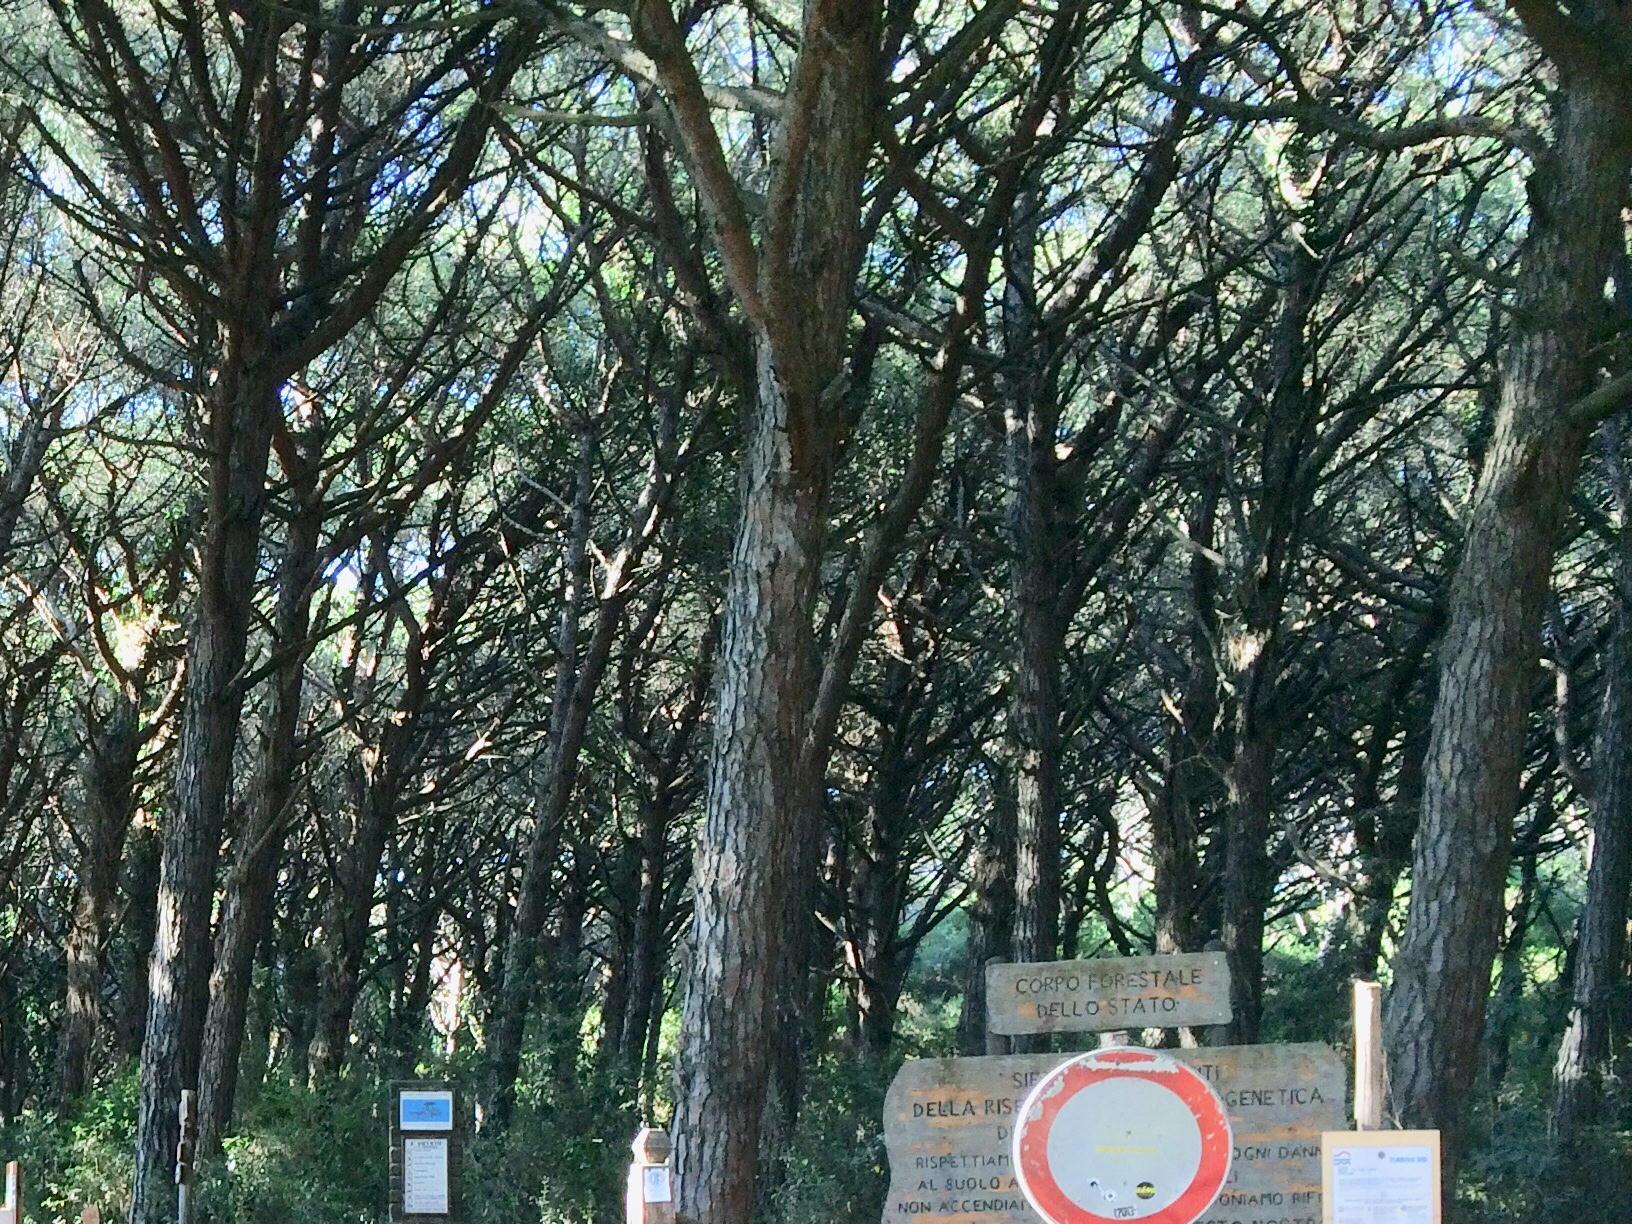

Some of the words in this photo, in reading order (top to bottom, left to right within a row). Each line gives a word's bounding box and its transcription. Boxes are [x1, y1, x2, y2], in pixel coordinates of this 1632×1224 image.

[1015, 975, 1080, 995] CORPO
[1088, 968, 1204, 990] FORESTALE
[1036, 1000, 1100, 1019] DELLO
[913, 1099, 976, 1118] DELLA
[984, 1098, 1021, 1117] RISE
[1223, 1087, 1325, 1108] GENETICA
[915, 1153, 1013, 1170] RISPETTIAM
[1278, 1144, 1322, 1160] DANN
[917, 1178, 939, 1192] AL
[945, 1176, 1001, 1191] SUOLO
[897, 1200, 932, 1214] NON
